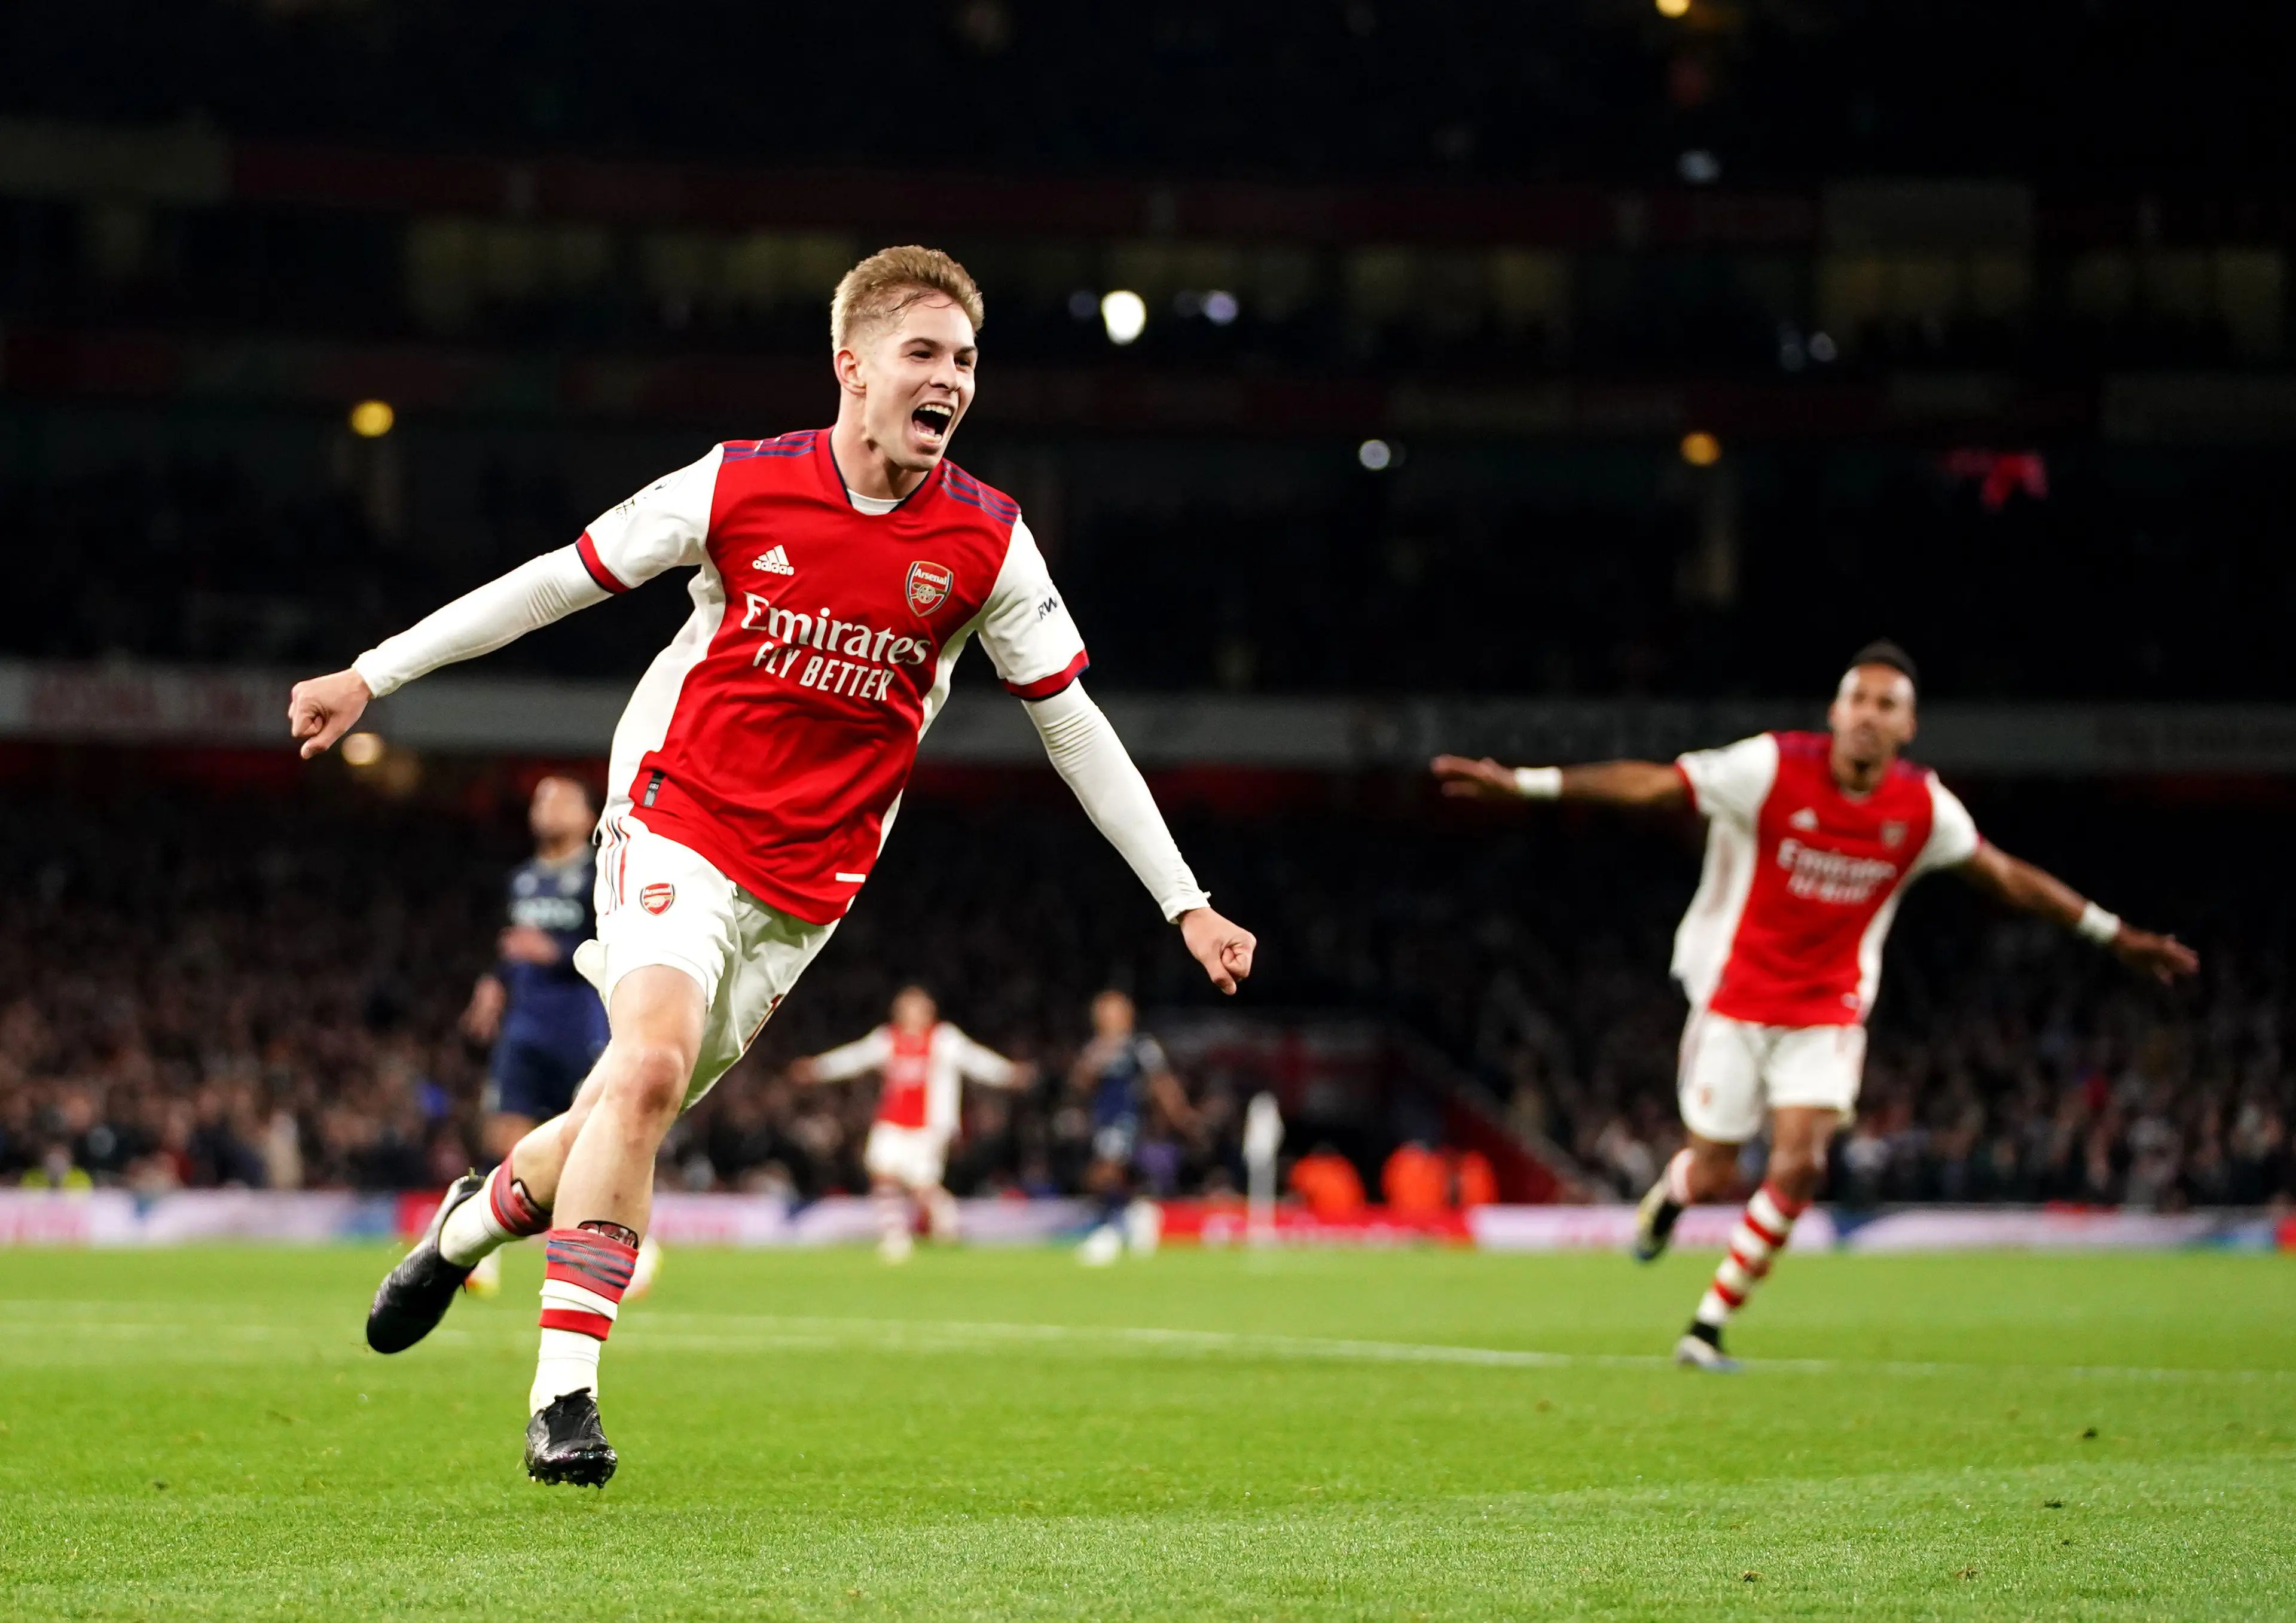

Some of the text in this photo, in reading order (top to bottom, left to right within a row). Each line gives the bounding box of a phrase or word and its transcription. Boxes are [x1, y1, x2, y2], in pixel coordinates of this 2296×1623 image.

[752, 559, 795, 576] adidas
[914, 568, 948, 585] Arsenal
[741, 591, 931, 665] Emirates
[753, 641, 894, 701] FLY BETTER
